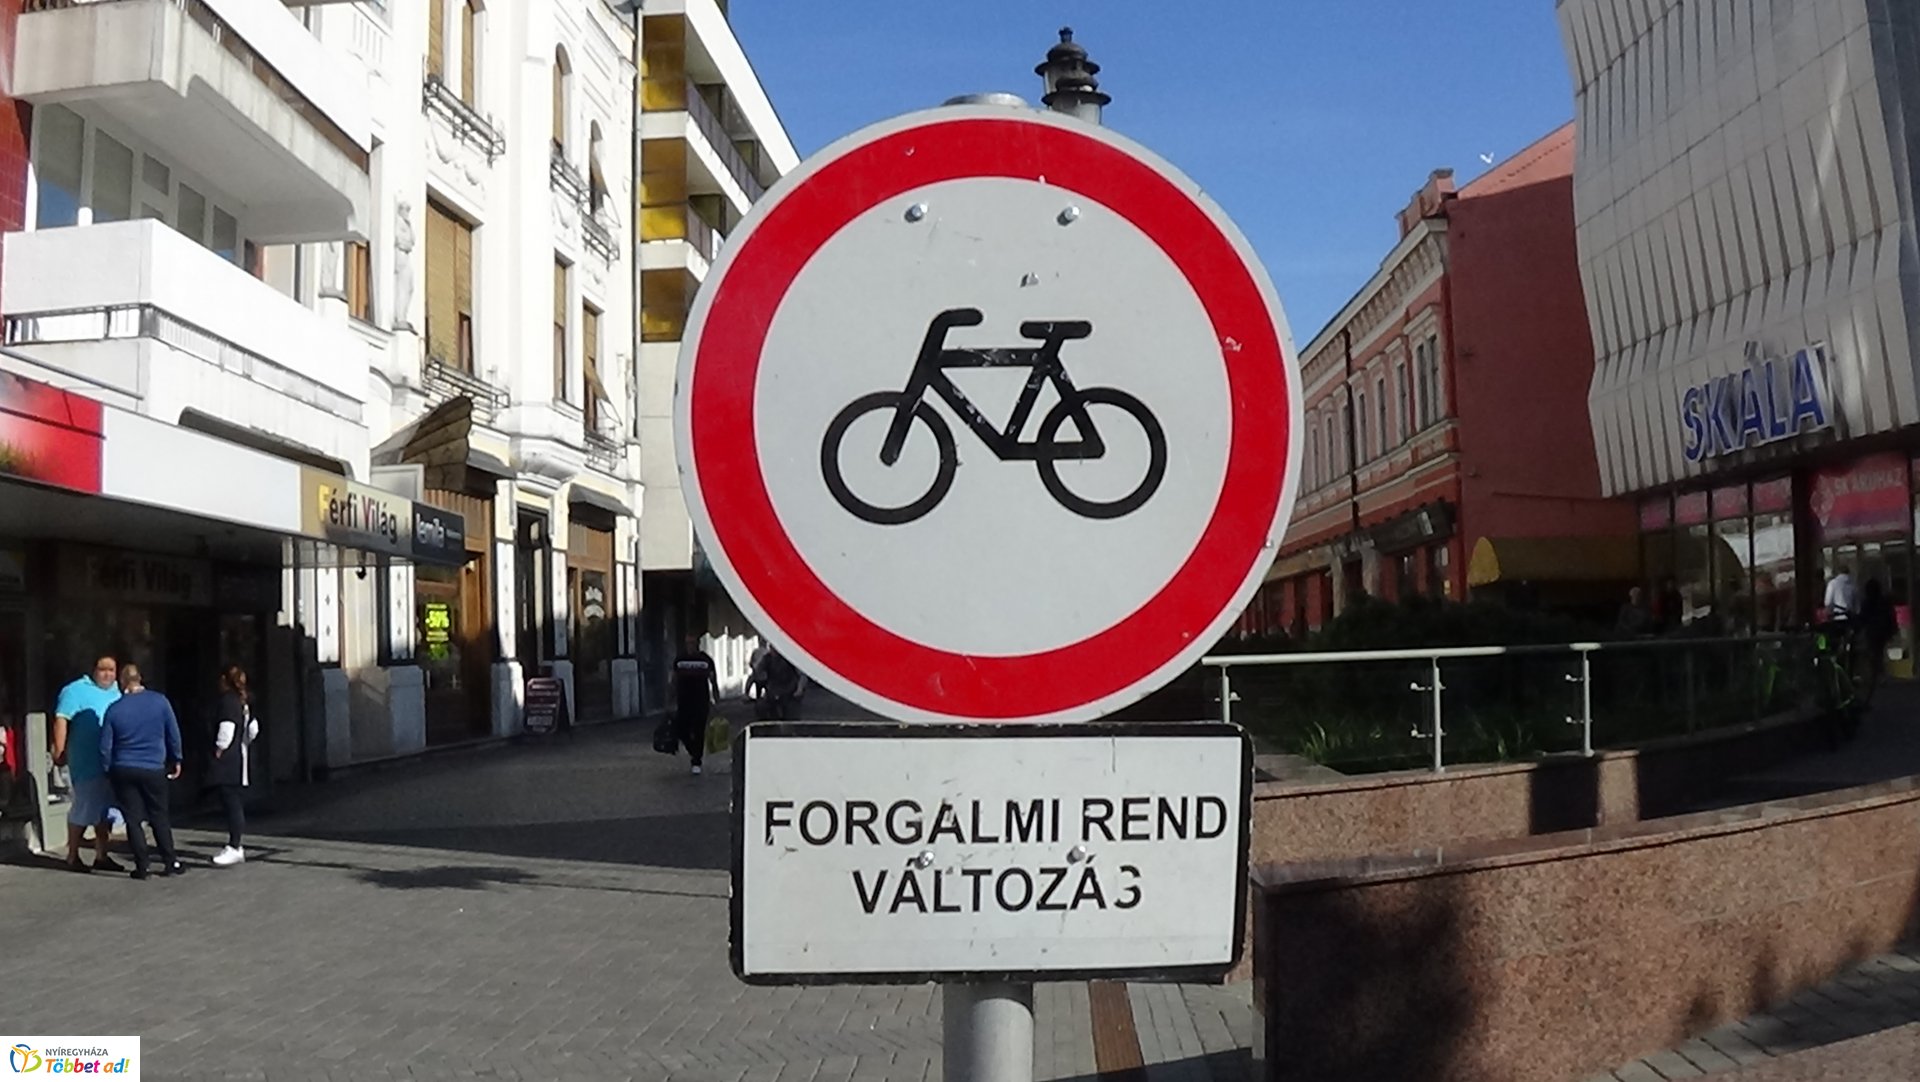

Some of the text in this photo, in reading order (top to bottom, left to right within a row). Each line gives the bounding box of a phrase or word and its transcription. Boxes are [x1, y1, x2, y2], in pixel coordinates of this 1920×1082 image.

[1683, 341, 1830, 462] SKÁLA
[318, 484, 397, 544] Férfi Világ
[765, 796, 1227, 846] FORGALMI REND
